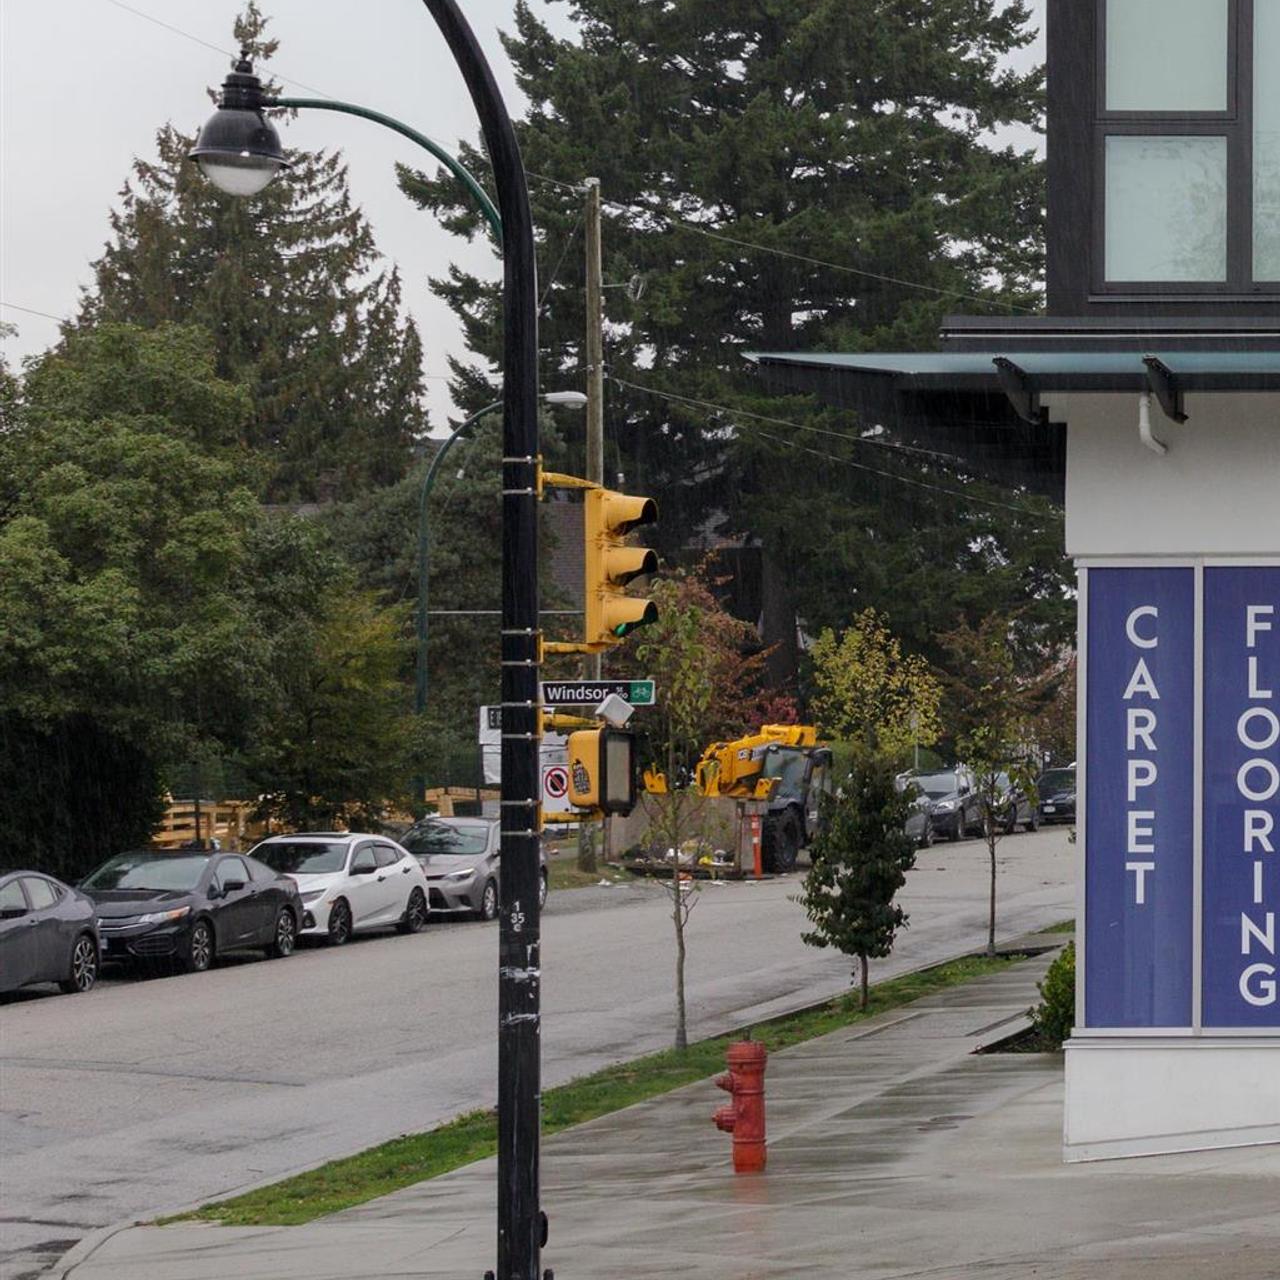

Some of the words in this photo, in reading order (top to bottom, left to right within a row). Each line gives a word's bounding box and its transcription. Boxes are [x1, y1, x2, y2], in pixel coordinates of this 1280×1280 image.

[547, 686, 609, 700] Windsor
[1122, 605, 1161, 905] CARPET
[1236, 605, 1280, 1006] FLOORING
[511, 913, 525, 924] 35
